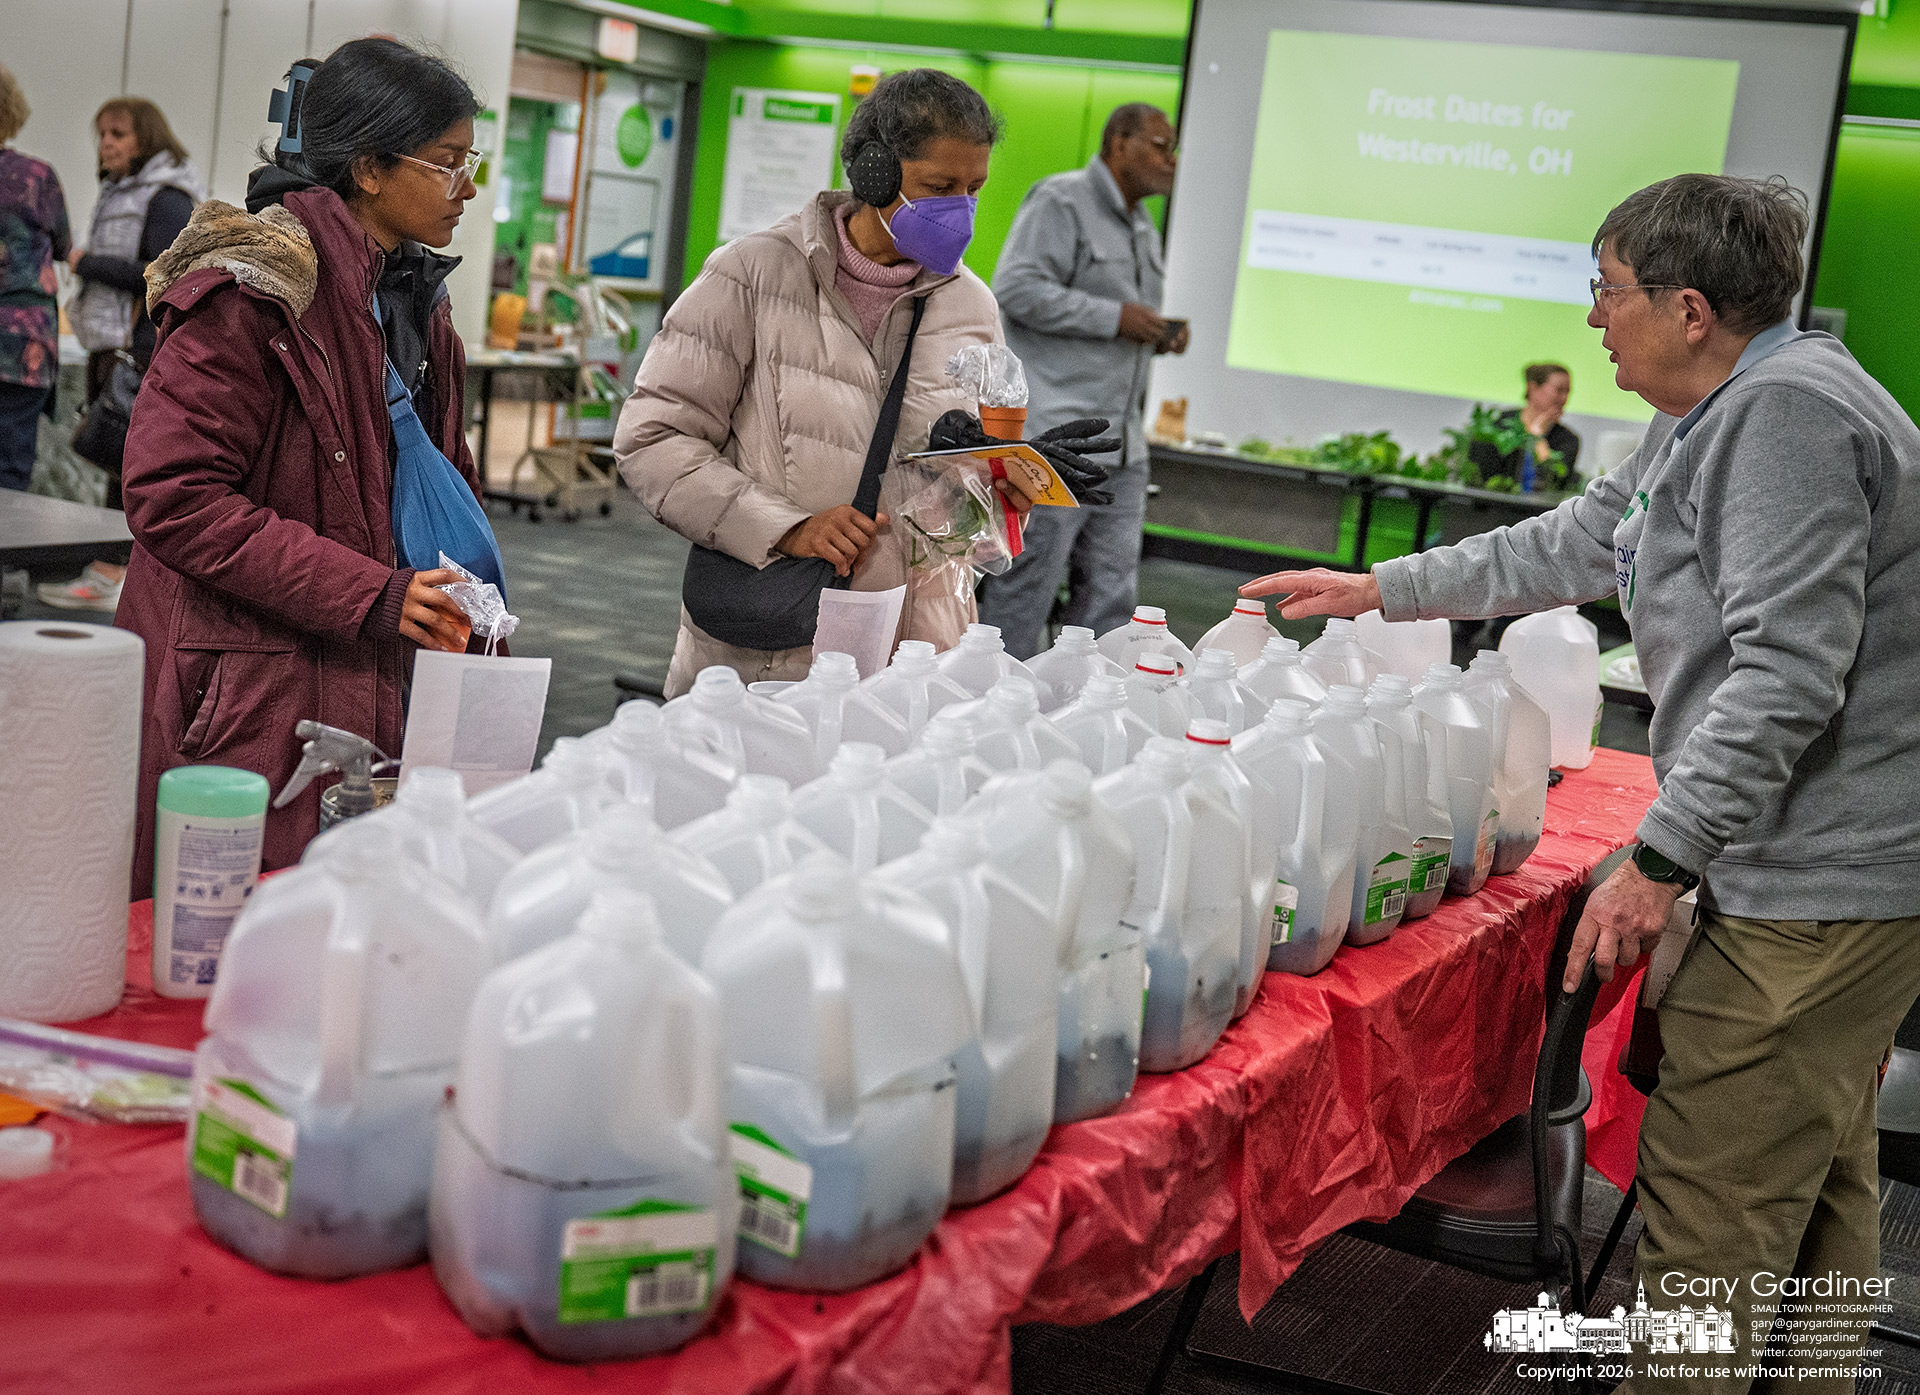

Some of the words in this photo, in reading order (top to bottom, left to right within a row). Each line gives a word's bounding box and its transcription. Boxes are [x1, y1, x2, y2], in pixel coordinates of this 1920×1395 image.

[1367, 88, 1436, 121] Frost
[1444, 93, 1523, 128] Dates
[1531, 100, 1575, 131] for
[1357, 131, 1518, 176] Westerville,
[1528, 146, 1573, 176] OH
